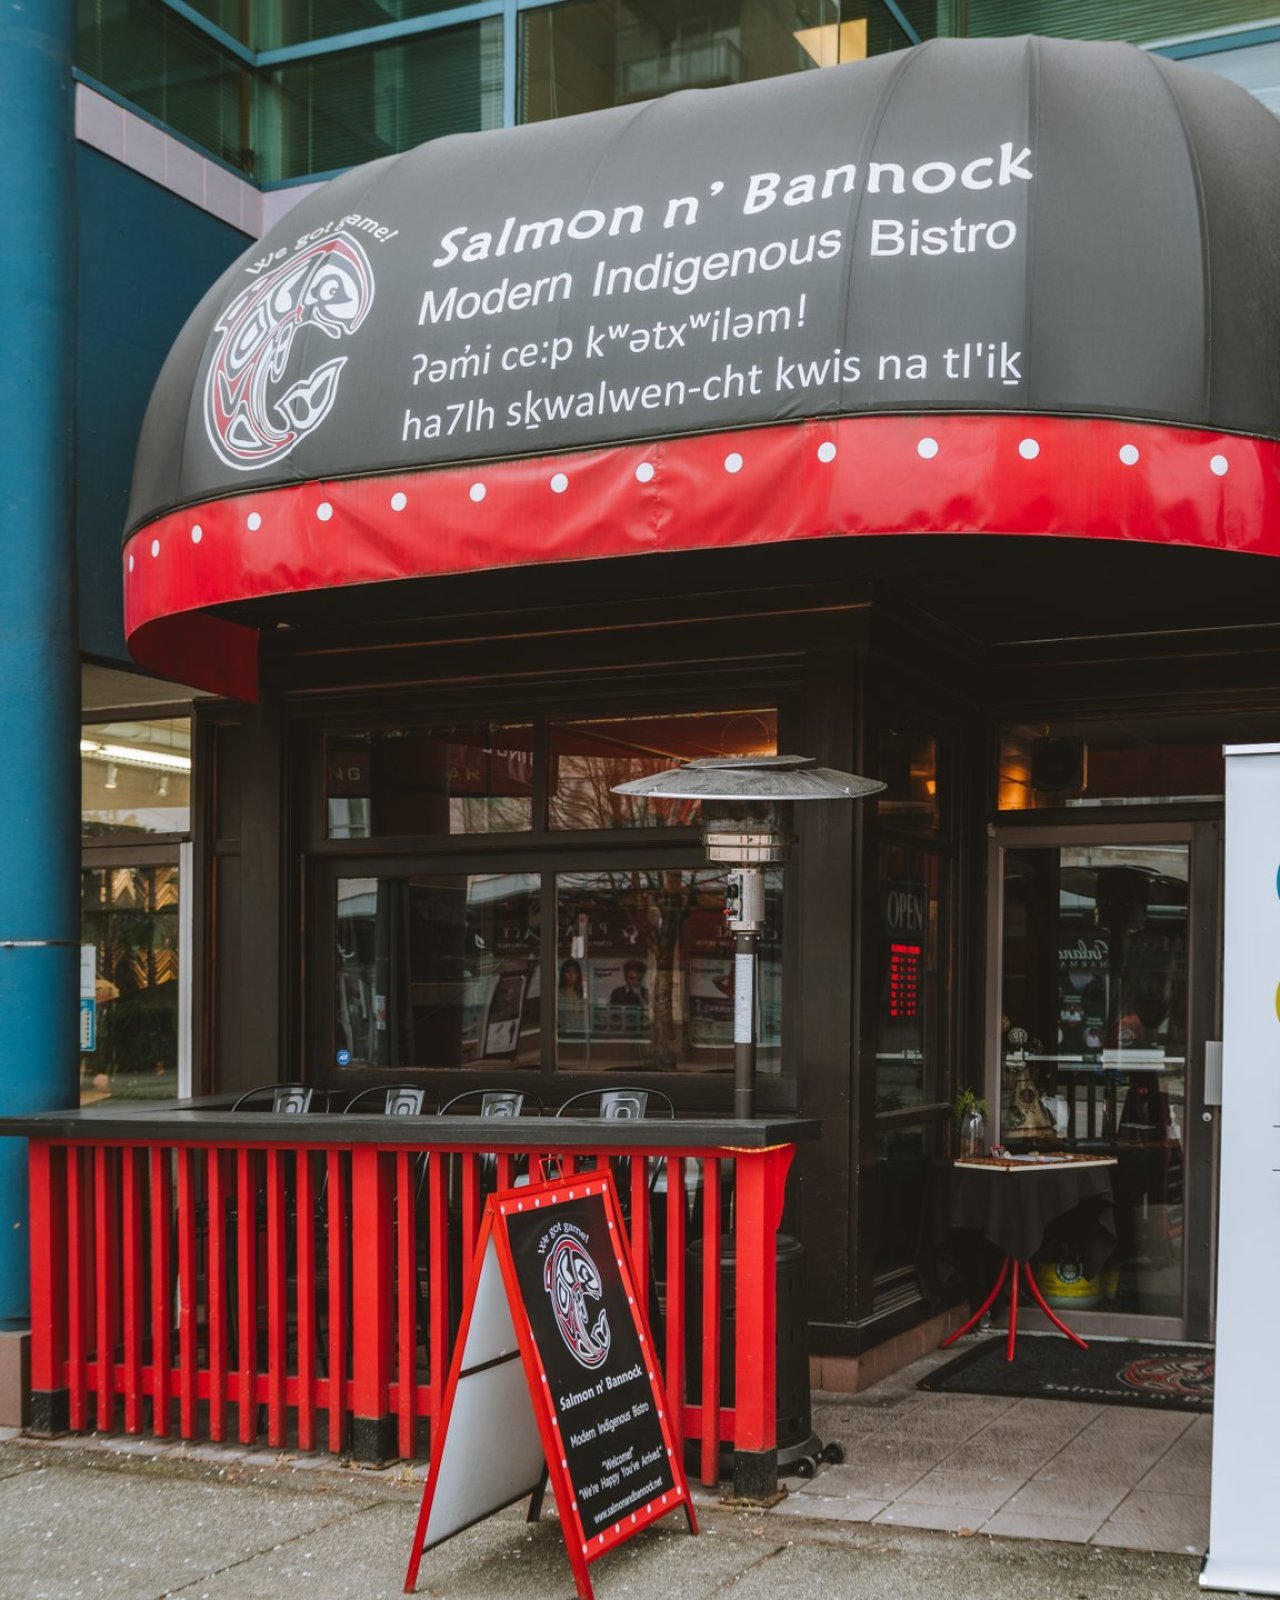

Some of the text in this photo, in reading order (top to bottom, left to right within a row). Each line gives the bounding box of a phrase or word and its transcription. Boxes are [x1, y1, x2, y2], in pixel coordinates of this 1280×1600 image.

[432, 141, 1035, 269] Salmon n' Bannock
[245, 212, 400, 275] We got game!
[417, 216, 1018, 326] Modern Indigenous Bistro
[501, 336, 573, 370] ce:p
[402, 398, 495, 442] ha7lh
[776, 355, 861, 392] kwis
[878, 353, 928, 381] na
[887, 890, 923, 931] OPEN
[537, 1221, 590, 1254] We got game!
[559, 1386, 596, 1412] Salmon
[604, 1363, 643, 1391] Bannock
[570, 1401, 650, 1449] Modern Indigenous Bistro
[600, 1471, 620, 1490] Happy
[620, 1460, 641, 1478] You've
